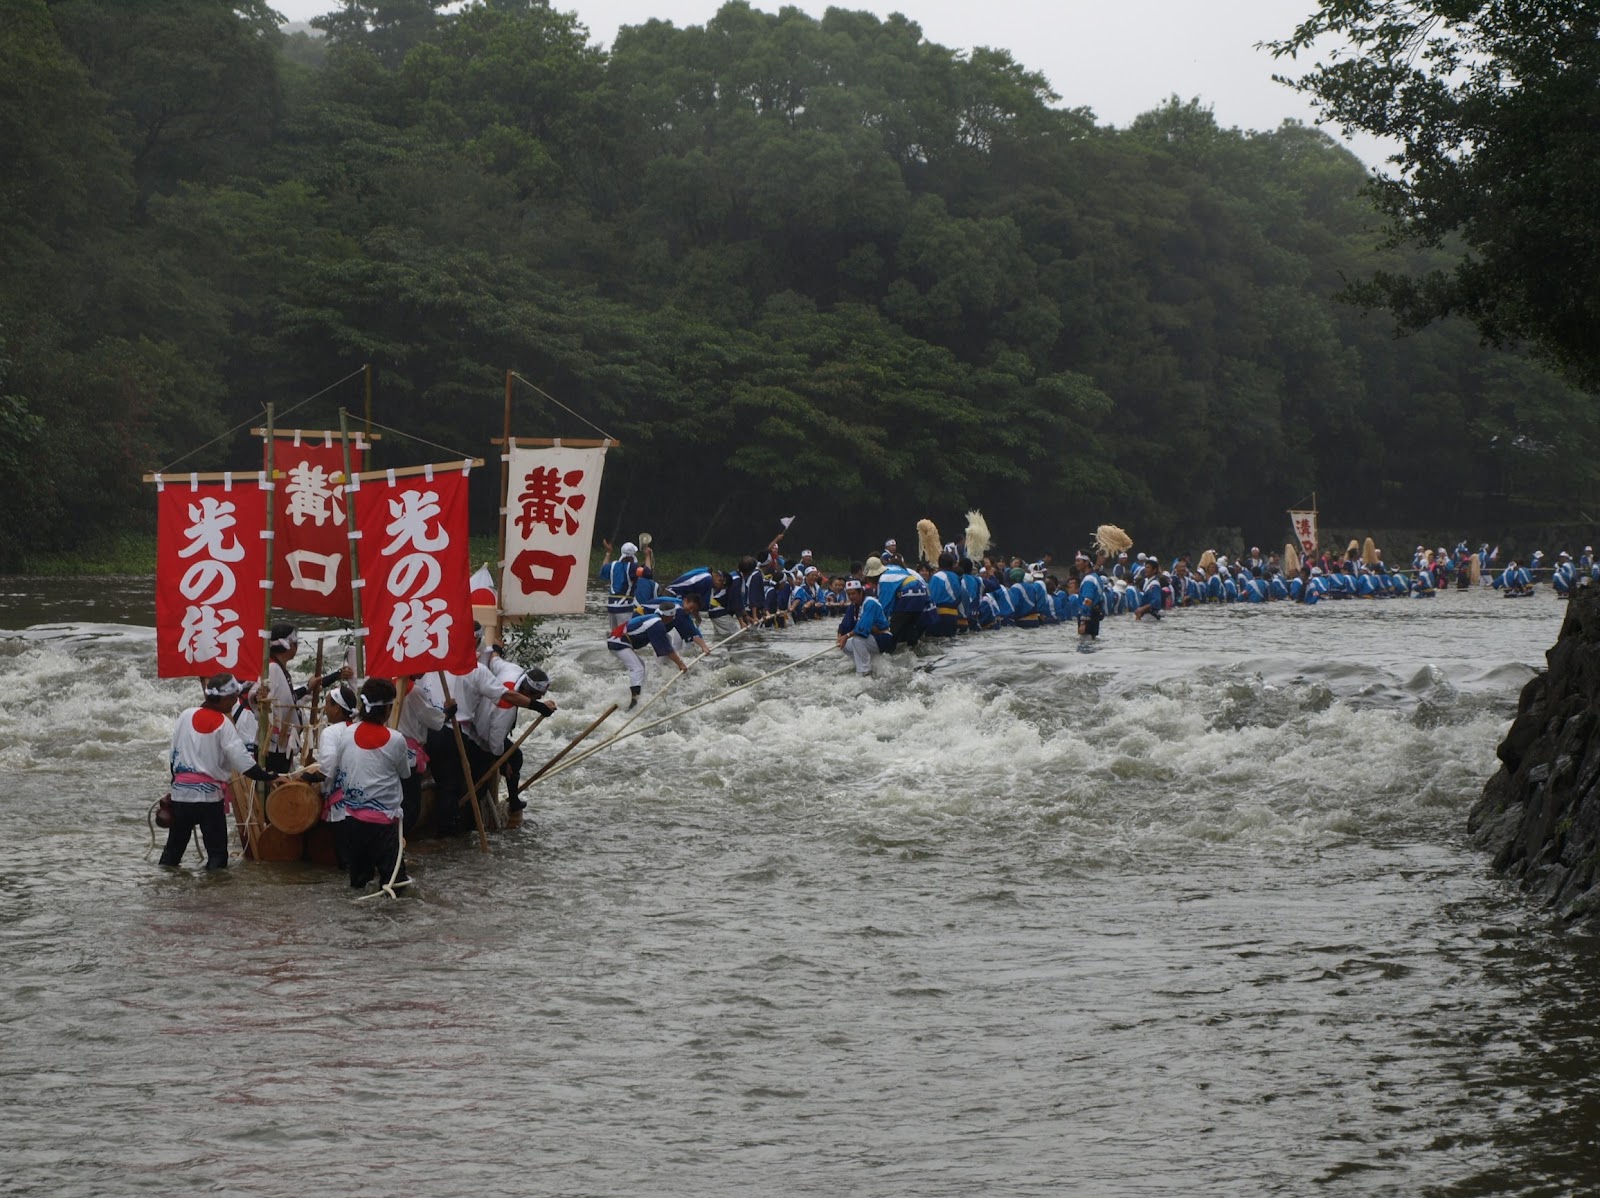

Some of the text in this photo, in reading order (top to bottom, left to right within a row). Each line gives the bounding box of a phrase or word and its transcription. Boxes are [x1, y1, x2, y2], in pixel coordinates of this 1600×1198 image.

[178, 497, 245, 668] 光の街
[381, 490, 454, 662] 光の街
[1296, 519, 1313, 552] 溝口
